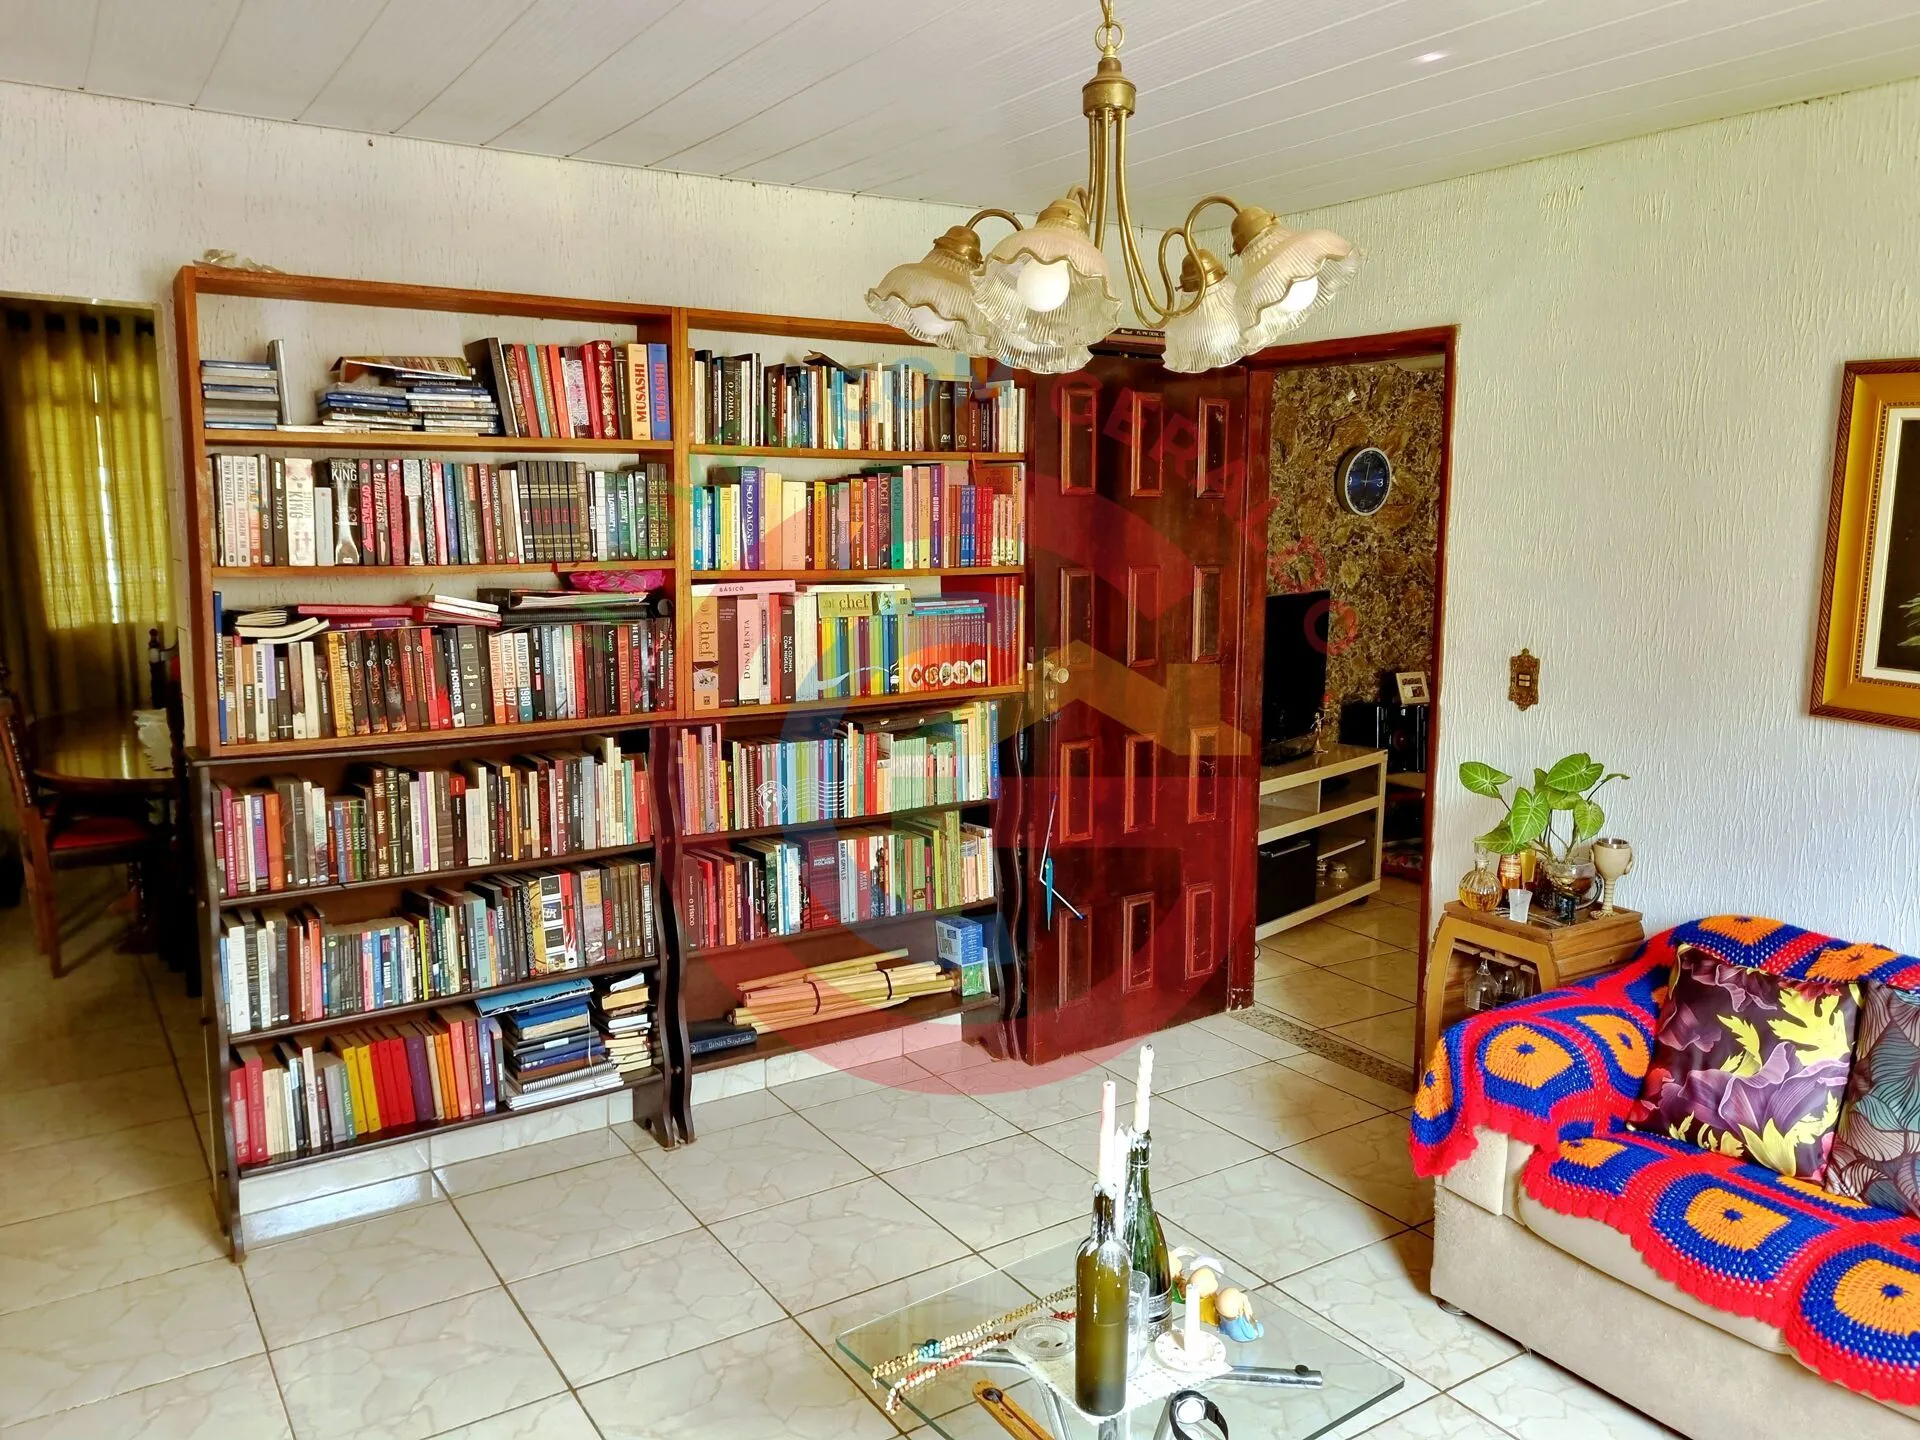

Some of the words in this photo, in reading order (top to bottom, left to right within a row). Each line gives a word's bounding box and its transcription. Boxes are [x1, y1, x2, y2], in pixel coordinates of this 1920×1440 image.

[634, 363, 647, 423] MUSASHI
[654, 363, 667, 422] MUSASHI
[223, 461, 231, 475] KING
[235, 461, 244, 475] KING
[248, 462, 256, 476] KING
[331, 461, 357, 470] STEPHEN
[331, 468, 357, 481] KING
[224, 478, 233, 501] STEPHEN
[236, 477, 245, 502] STEPHEN
[248, 477, 258, 502] STEPHEN
[480, 475, 491, 510] EXORCISTA
[649, 480, 657, 495] POE
[880, 477, 889, 510] VOGEL
[289, 491, 303, 518] KING
[650, 497, 658, 521] ALLAN
[746, 484, 754, 546] SOLOMONS
[651, 523, 659, 547] EDGAR
[719, 584, 744, 593] BÁSICO
[839, 593, 870, 609] chef
[700, 621, 715, 658] chef
[743, 620, 751, 649] BENTA
[788, 636, 793, 646] NA
[491, 640, 499, 661] DAVID
[504, 639, 513, 661] DAVID
[517, 638, 527, 660] DAVID
[492, 663, 500, 686] PEACE
[504, 663, 514, 686] PEACE
[519, 662, 528, 686] PEACE
[743, 652, 751, 679] DONA
[451, 669, 462, 707] HORROR
[506, 688, 516, 705] 1977
[520, 687, 531, 706] 1980
[344, 1090, 352, 1115] WALDEN
